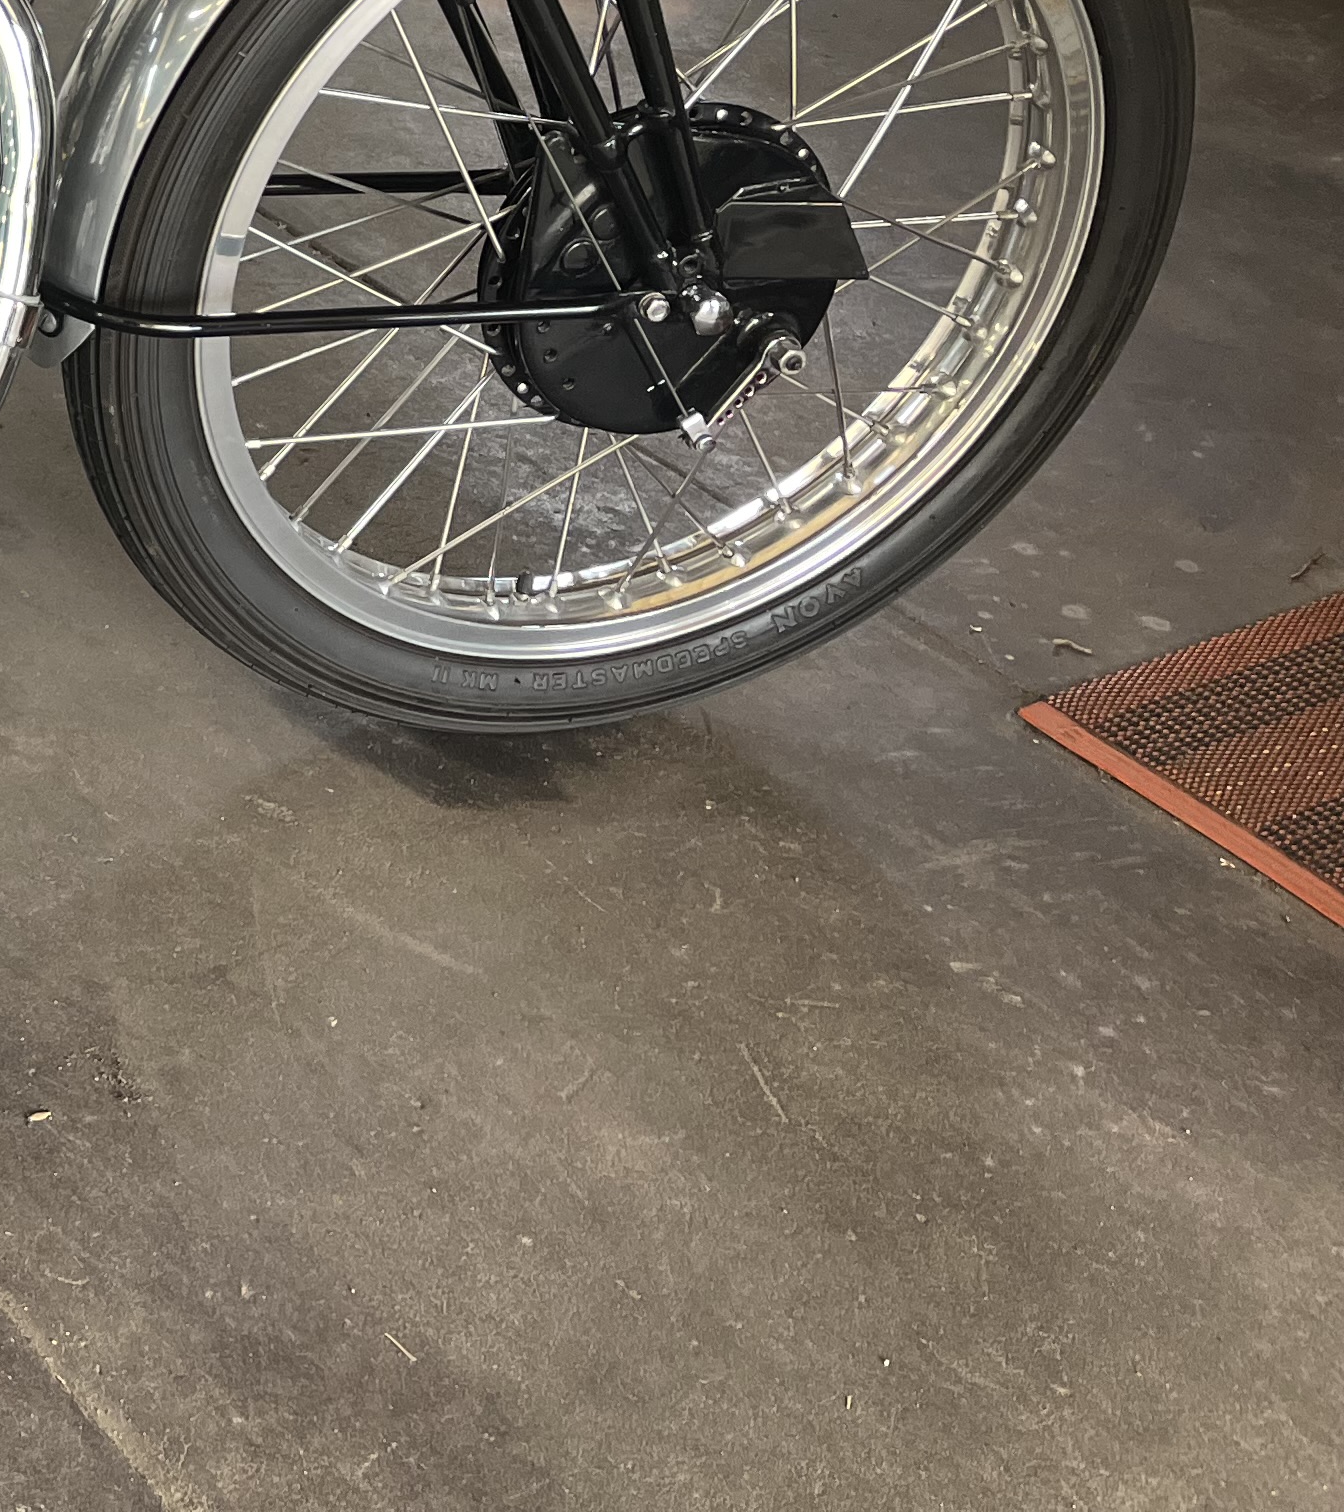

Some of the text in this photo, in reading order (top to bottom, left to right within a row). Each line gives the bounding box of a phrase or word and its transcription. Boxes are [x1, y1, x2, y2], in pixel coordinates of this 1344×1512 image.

[769, 566, 865, 634] AVON
[461, 669, 500, 691] MK
[532, 629, 749, 691] SPEEDMASTER
